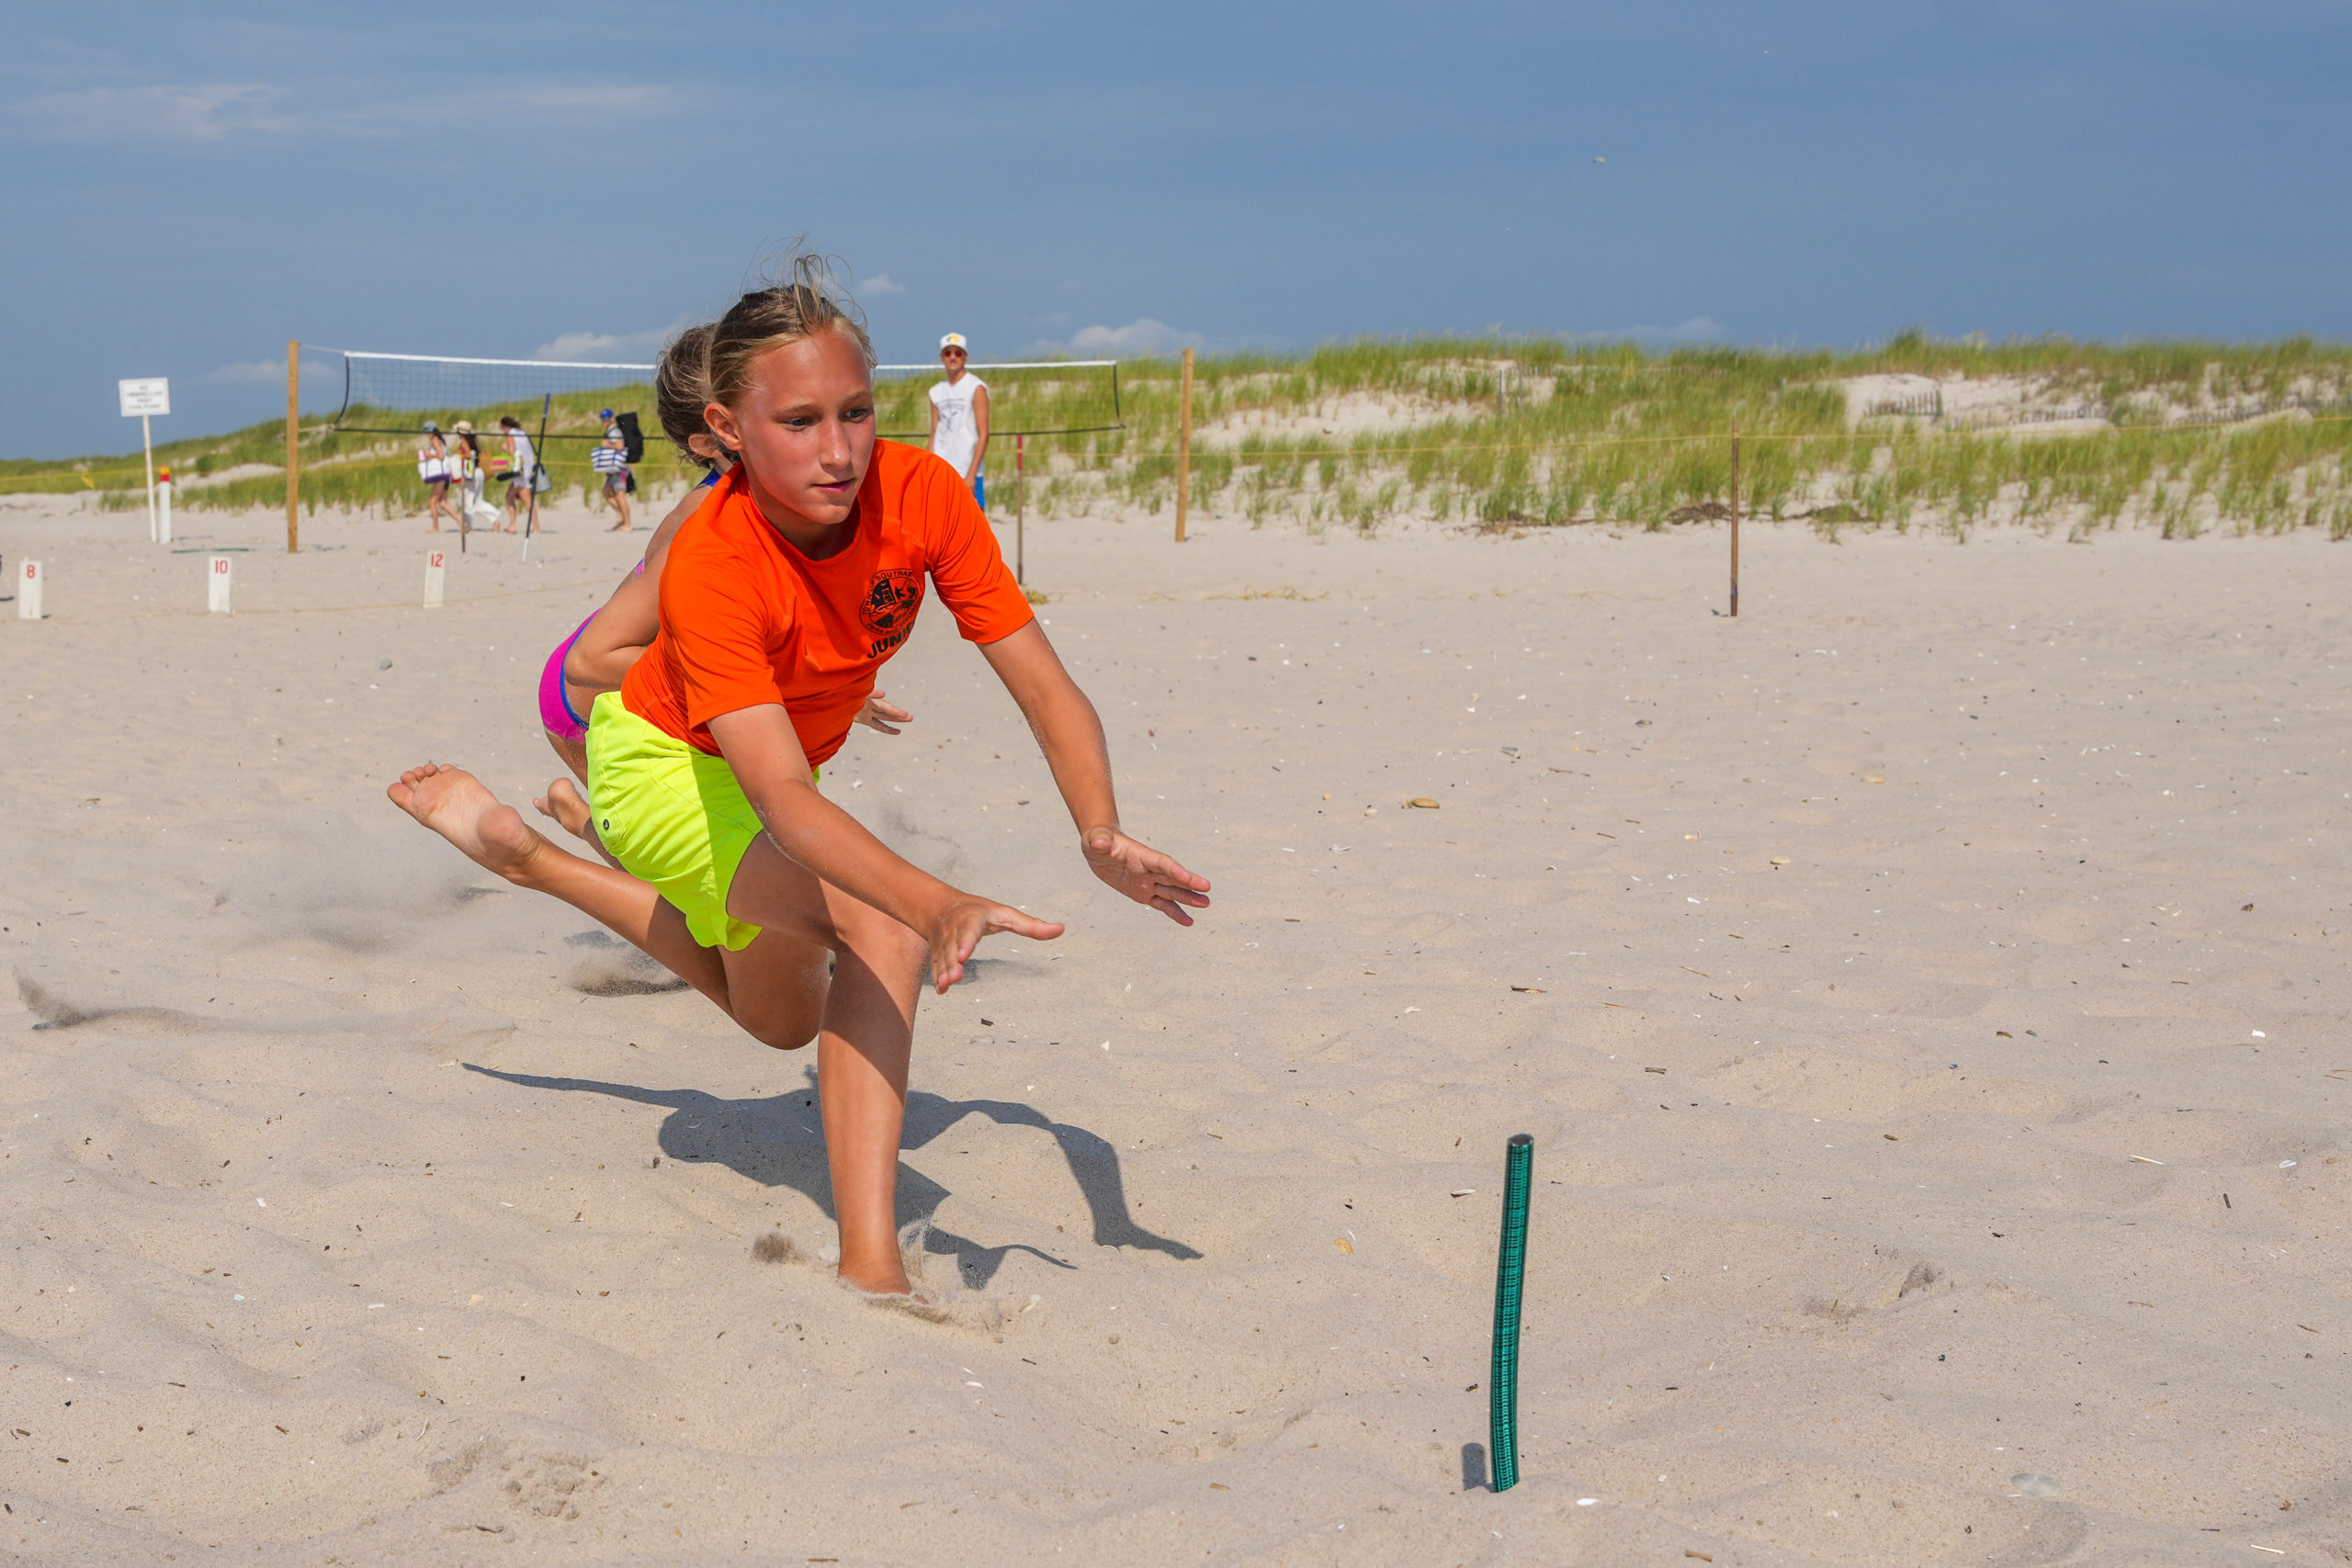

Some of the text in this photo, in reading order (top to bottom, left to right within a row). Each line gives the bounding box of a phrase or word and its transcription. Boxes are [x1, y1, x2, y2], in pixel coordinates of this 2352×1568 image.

[215, 559, 228, 574] 10
[431, 553, 443, 568] 12
[27, 564, 36, 579] 8
